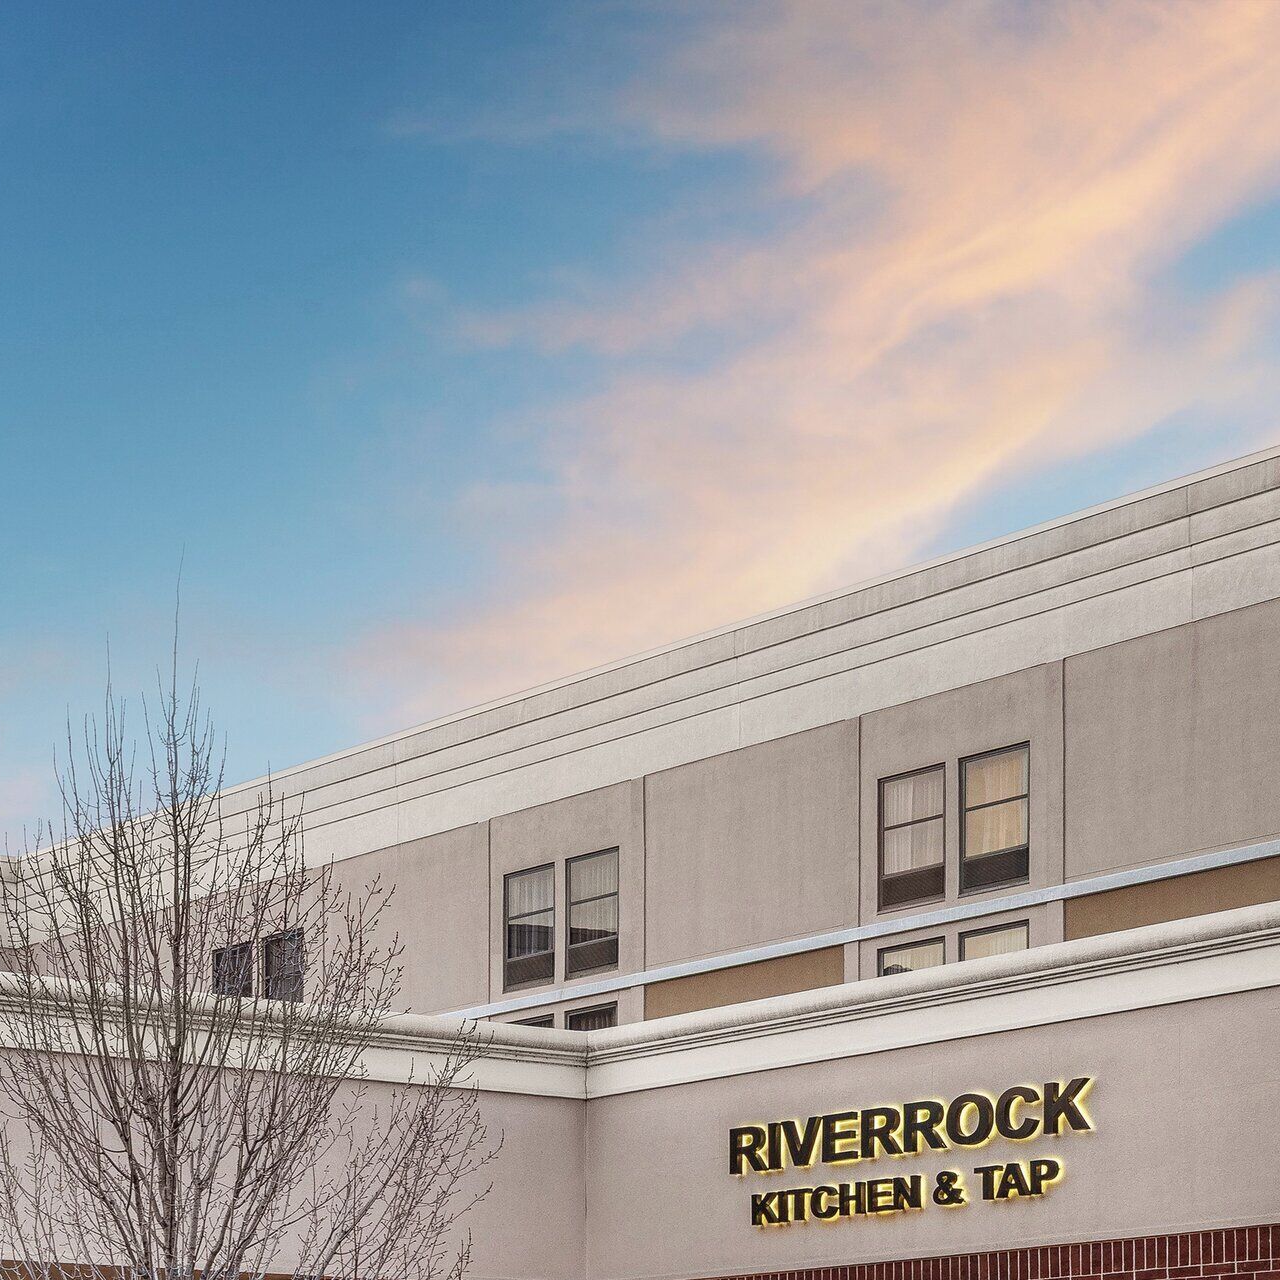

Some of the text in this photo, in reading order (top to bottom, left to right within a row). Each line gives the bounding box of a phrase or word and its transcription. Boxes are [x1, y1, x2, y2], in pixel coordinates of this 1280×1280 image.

[729, 1077, 1091, 1175] RIVERROCK
[751, 1159, 1059, 1226] KITCHEN & TAP
